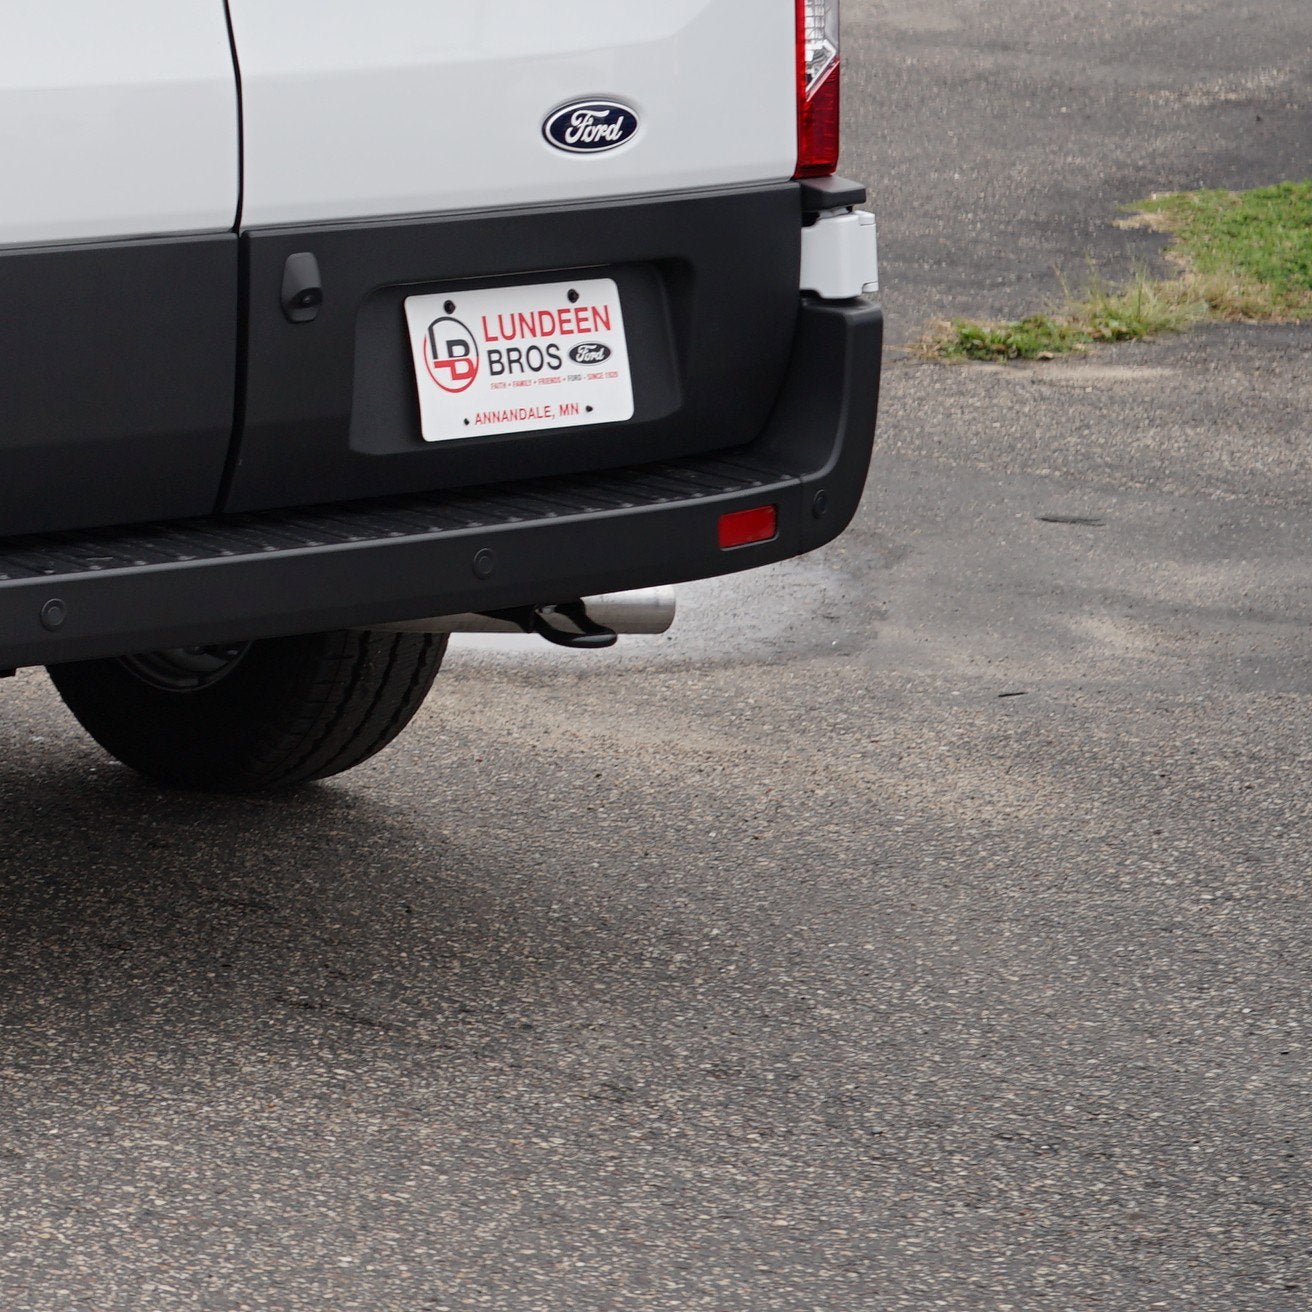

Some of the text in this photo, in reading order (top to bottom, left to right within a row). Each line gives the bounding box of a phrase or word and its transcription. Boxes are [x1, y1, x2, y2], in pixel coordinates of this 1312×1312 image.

[564, 109, 625, 144] Ford
[481, 304, 612, 343] LUNDEEN
[487, 343, 607, 377] BROS Ford
[475, 402, 580, 426] ANNANDALE, MN
